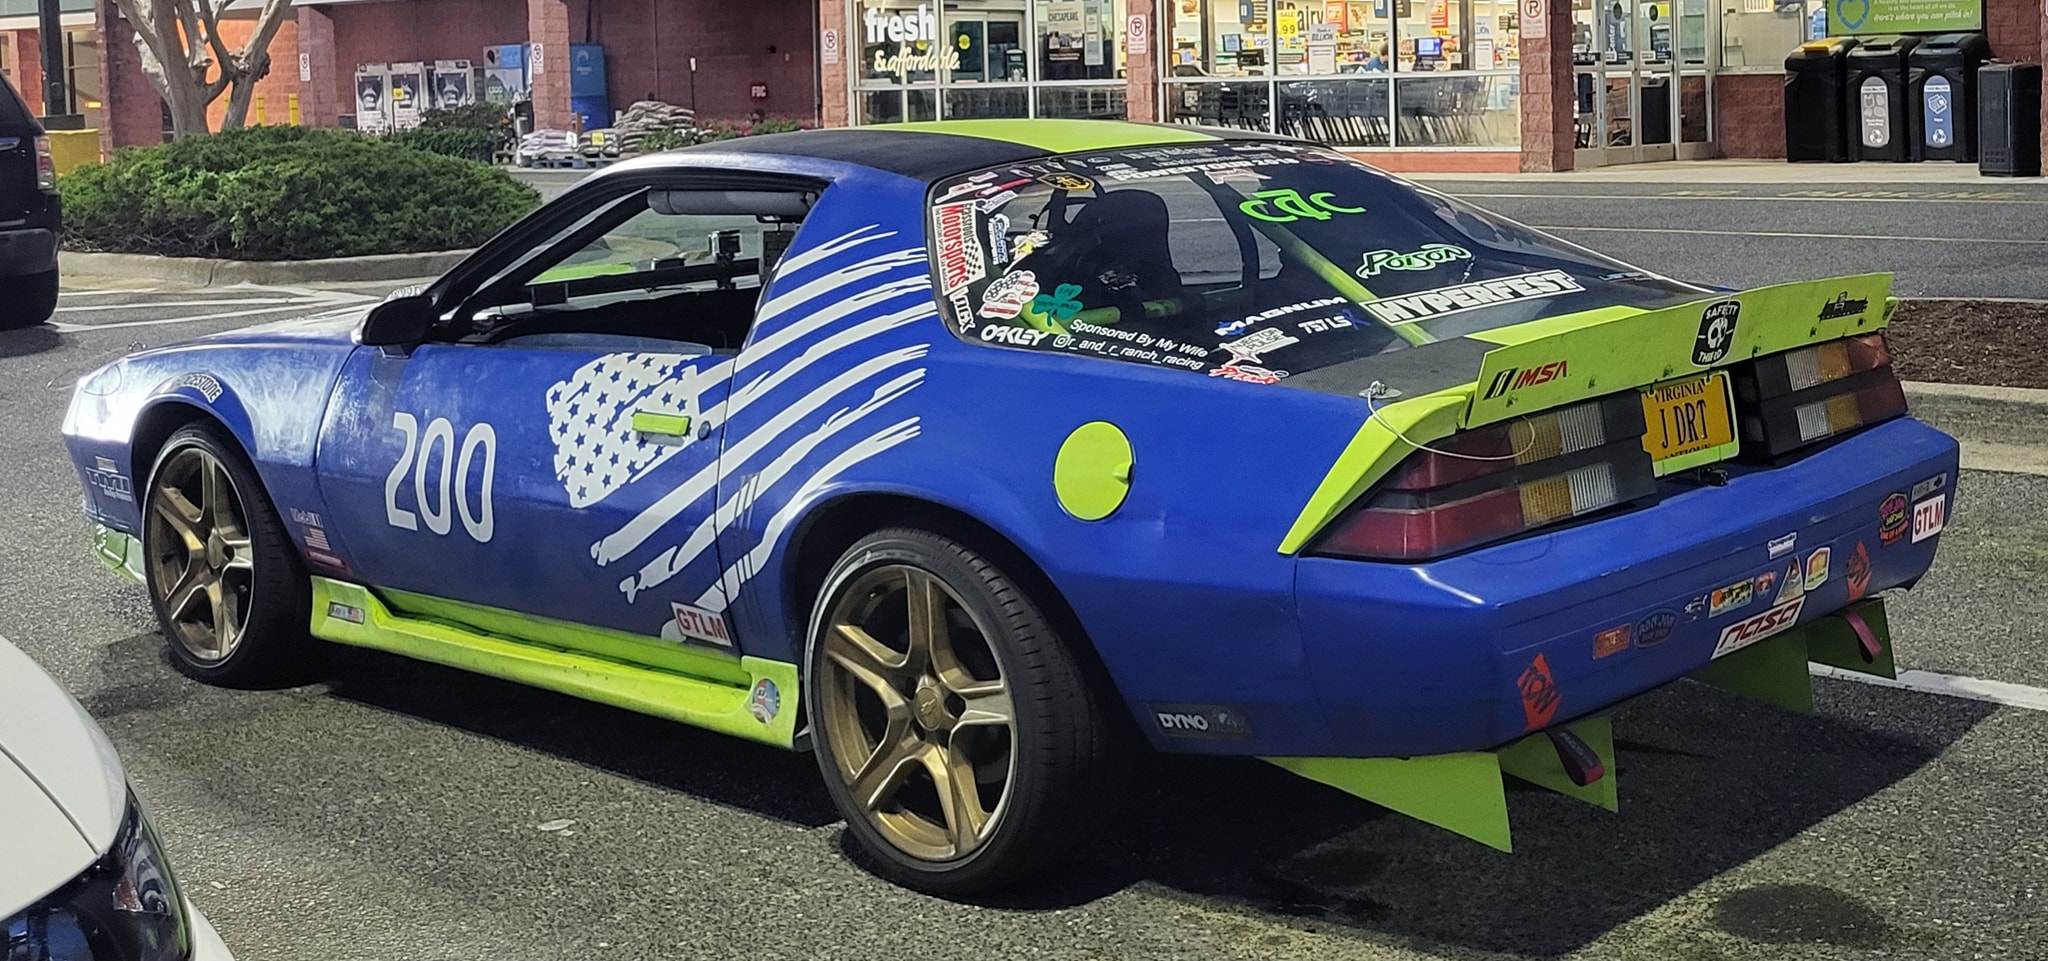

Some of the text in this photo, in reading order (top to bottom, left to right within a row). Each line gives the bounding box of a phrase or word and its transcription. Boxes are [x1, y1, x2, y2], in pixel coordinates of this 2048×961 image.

[864, 4, 936, 43] fresh
[940, 204, 970, 289] Motorsports
[1214, 296, 1348, 336] MAGNUM
[1369, 272, 1573, 323] HYPERFEST
[1706, 305, 1738, 319] SAFETY
[981, 325, 1049, 346] OAKLEY
[1070, 319, 1209, 358] Sponsored By My Wife
[1511, 360, 1567, 391] IMSA
[1653, 380, 1705, 404] VIRGINIA
[1660, 399, 1708, 449] J DRT
[385, 411, 497, 543] 200
[1914, 500, 1943, 536] GTLM
[676, 608, 728, 641] GTLM
[1719, 601, 1802, 650] nasa
[1157, 713, 1209, 731] DYNO
